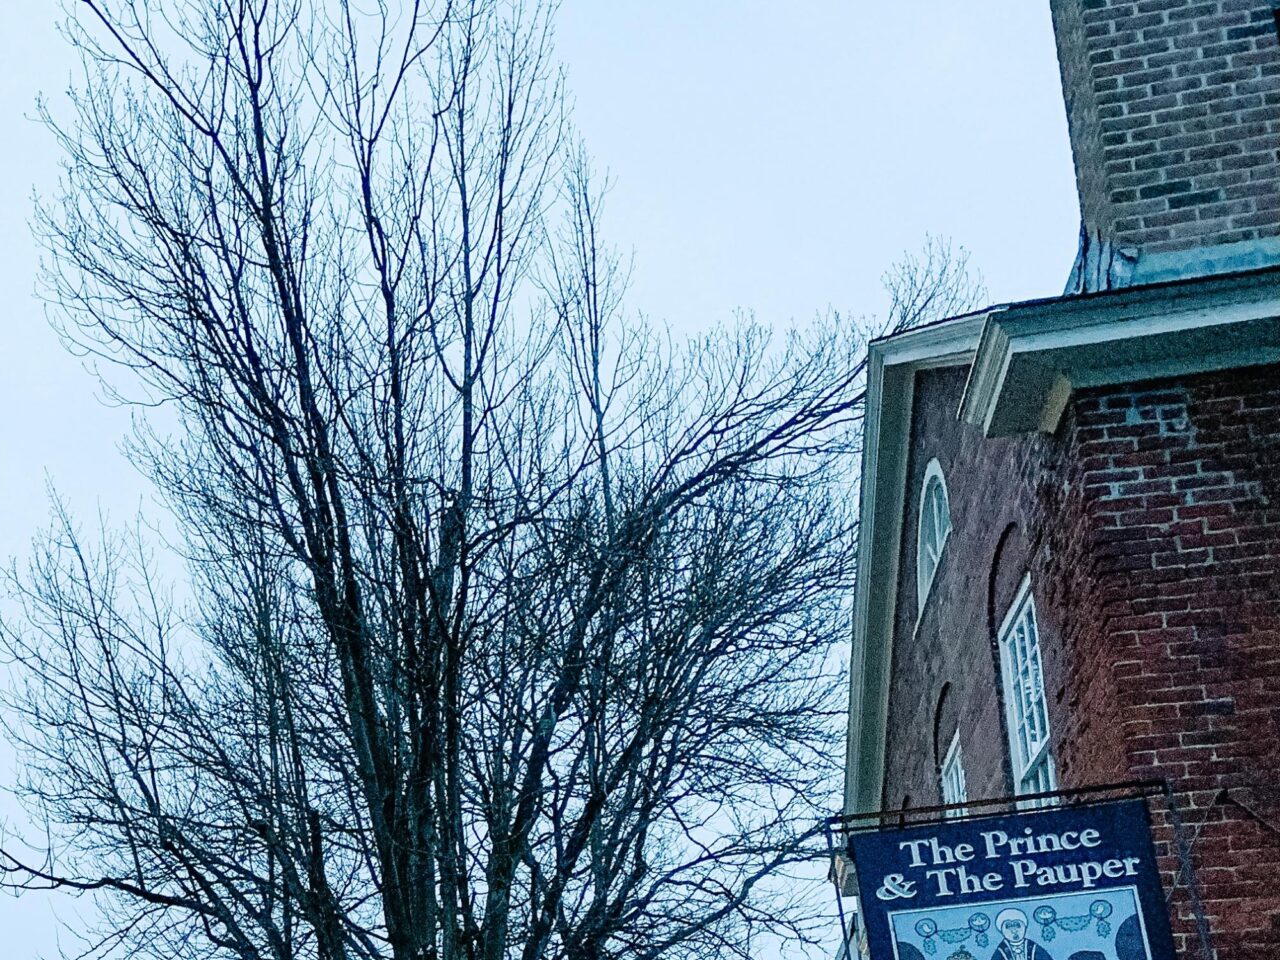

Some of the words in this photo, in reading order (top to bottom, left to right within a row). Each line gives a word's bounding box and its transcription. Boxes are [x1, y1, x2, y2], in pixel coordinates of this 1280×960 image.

[899, 836, 975, 867] The
[979, 827, 1102, 859] Prince
[876, 873, 918, 900] &
[926, 865, 1004, 897] The
[1008, 856, 1141, 888] Pauper
